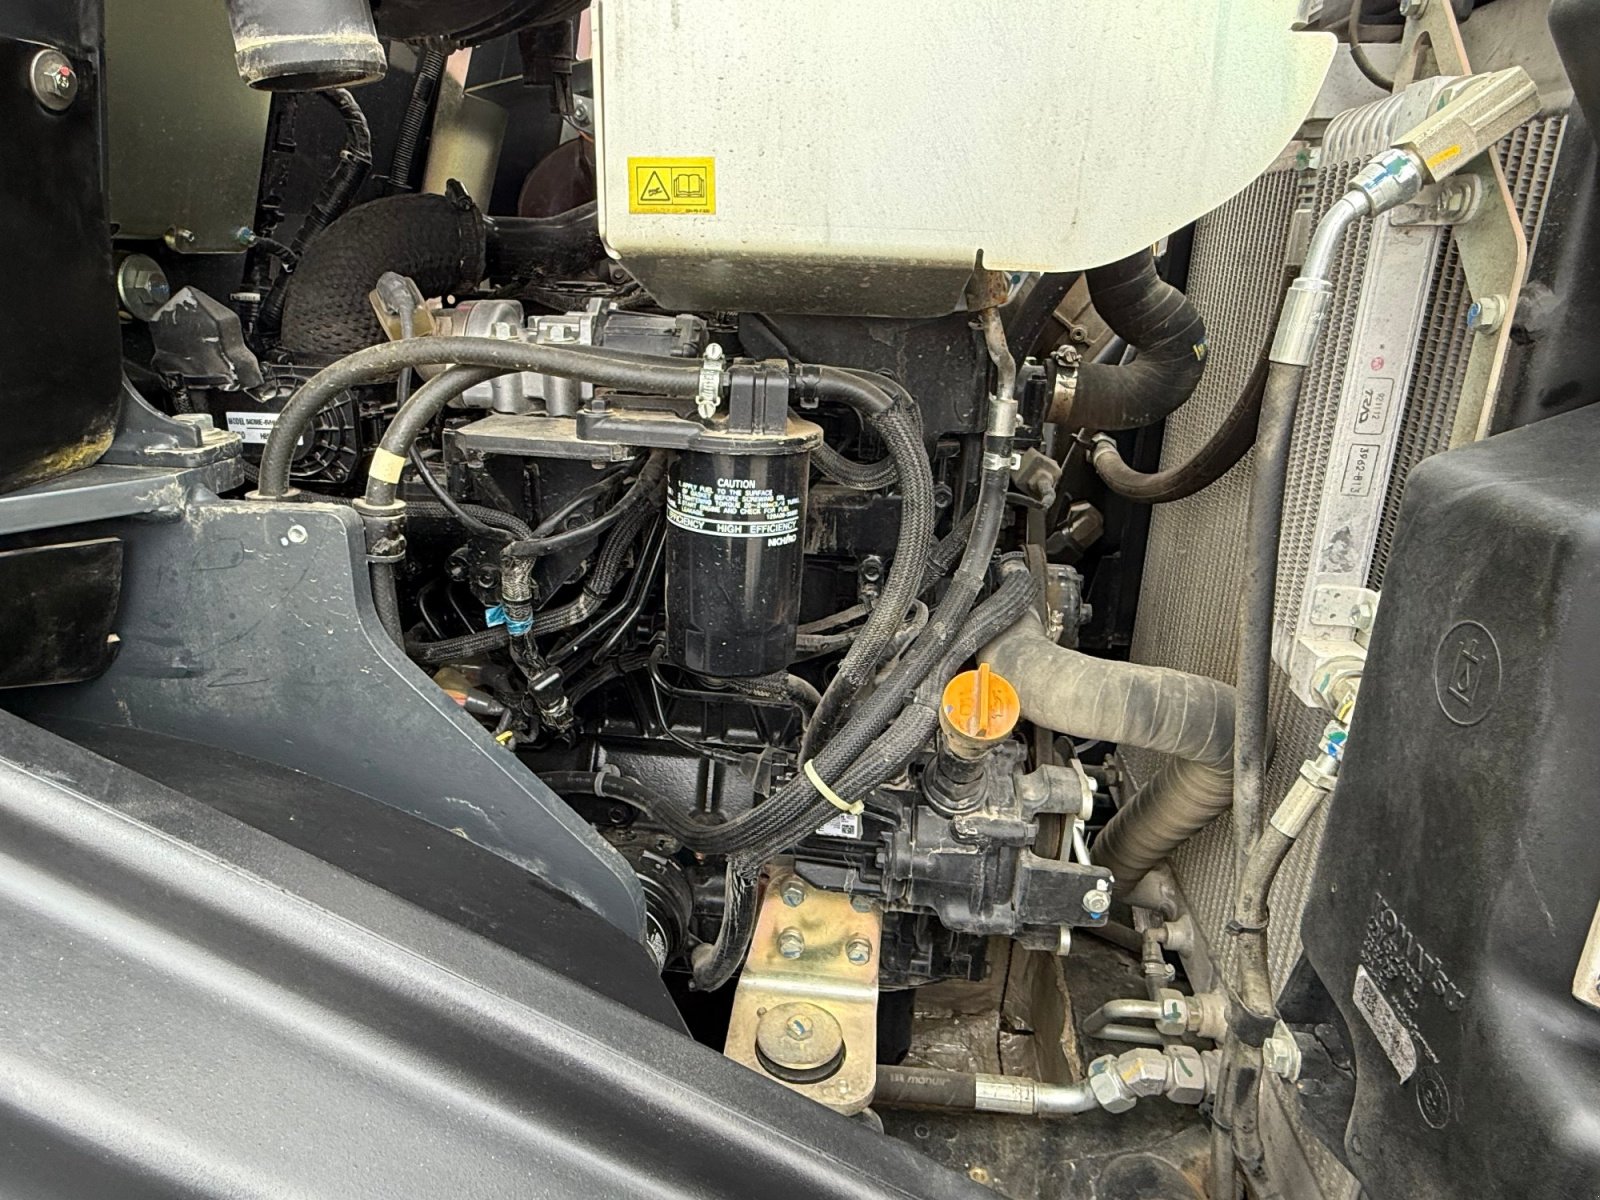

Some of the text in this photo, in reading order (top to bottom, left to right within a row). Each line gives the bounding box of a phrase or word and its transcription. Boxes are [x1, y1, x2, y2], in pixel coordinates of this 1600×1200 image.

[717, 478, 756, 488] CAUTION
[715, 501, 741, 509] TORQUE
[763, 507, 775, 515] FOR
[716, 524, 743, 533] HIGH
[750, 520, 797, 534] EFFICIENCY
